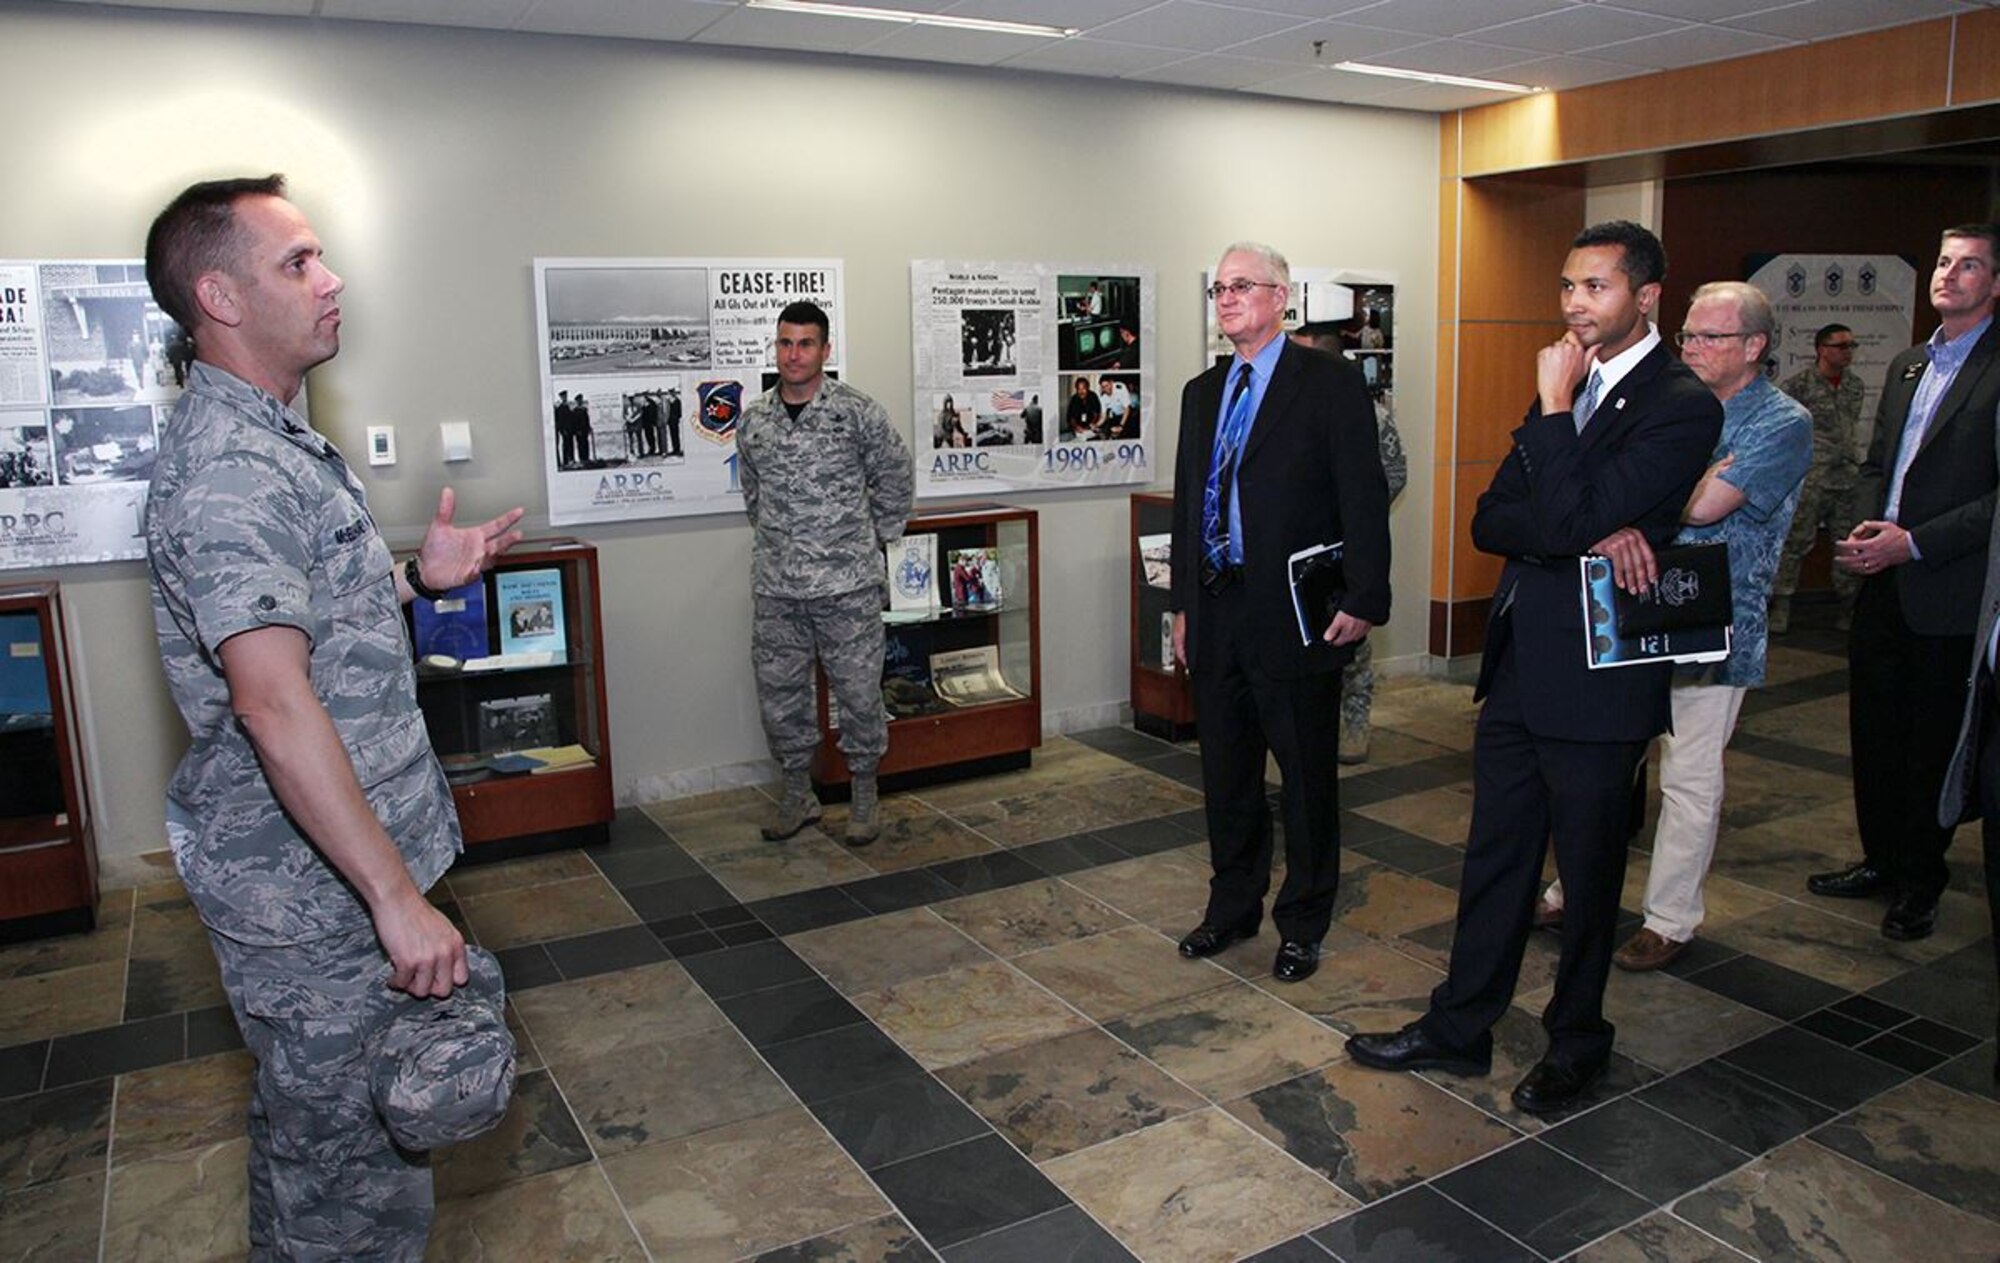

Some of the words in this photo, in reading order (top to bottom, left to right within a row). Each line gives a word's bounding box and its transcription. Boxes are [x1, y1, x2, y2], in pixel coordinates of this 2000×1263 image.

[720, 272, 825, 294] CEASE-FIRE!
[0, 288, 27, 304] DE
[932, 287, 965, 296] Pentagon
[991, 287, 1010, 296] plans
[714, 299, 726, 309] All
[743, 298, 757, 309] Out
[760, 299, 769, 308] of
[932, 296, 963, 305] 250,000
[998, 297, 1016, 305] Saudi
[1018, 297, 1041, 305] Arabia
[930, 452, 989, 473] ARPC
[596, 472, 662, 494] ARPC
